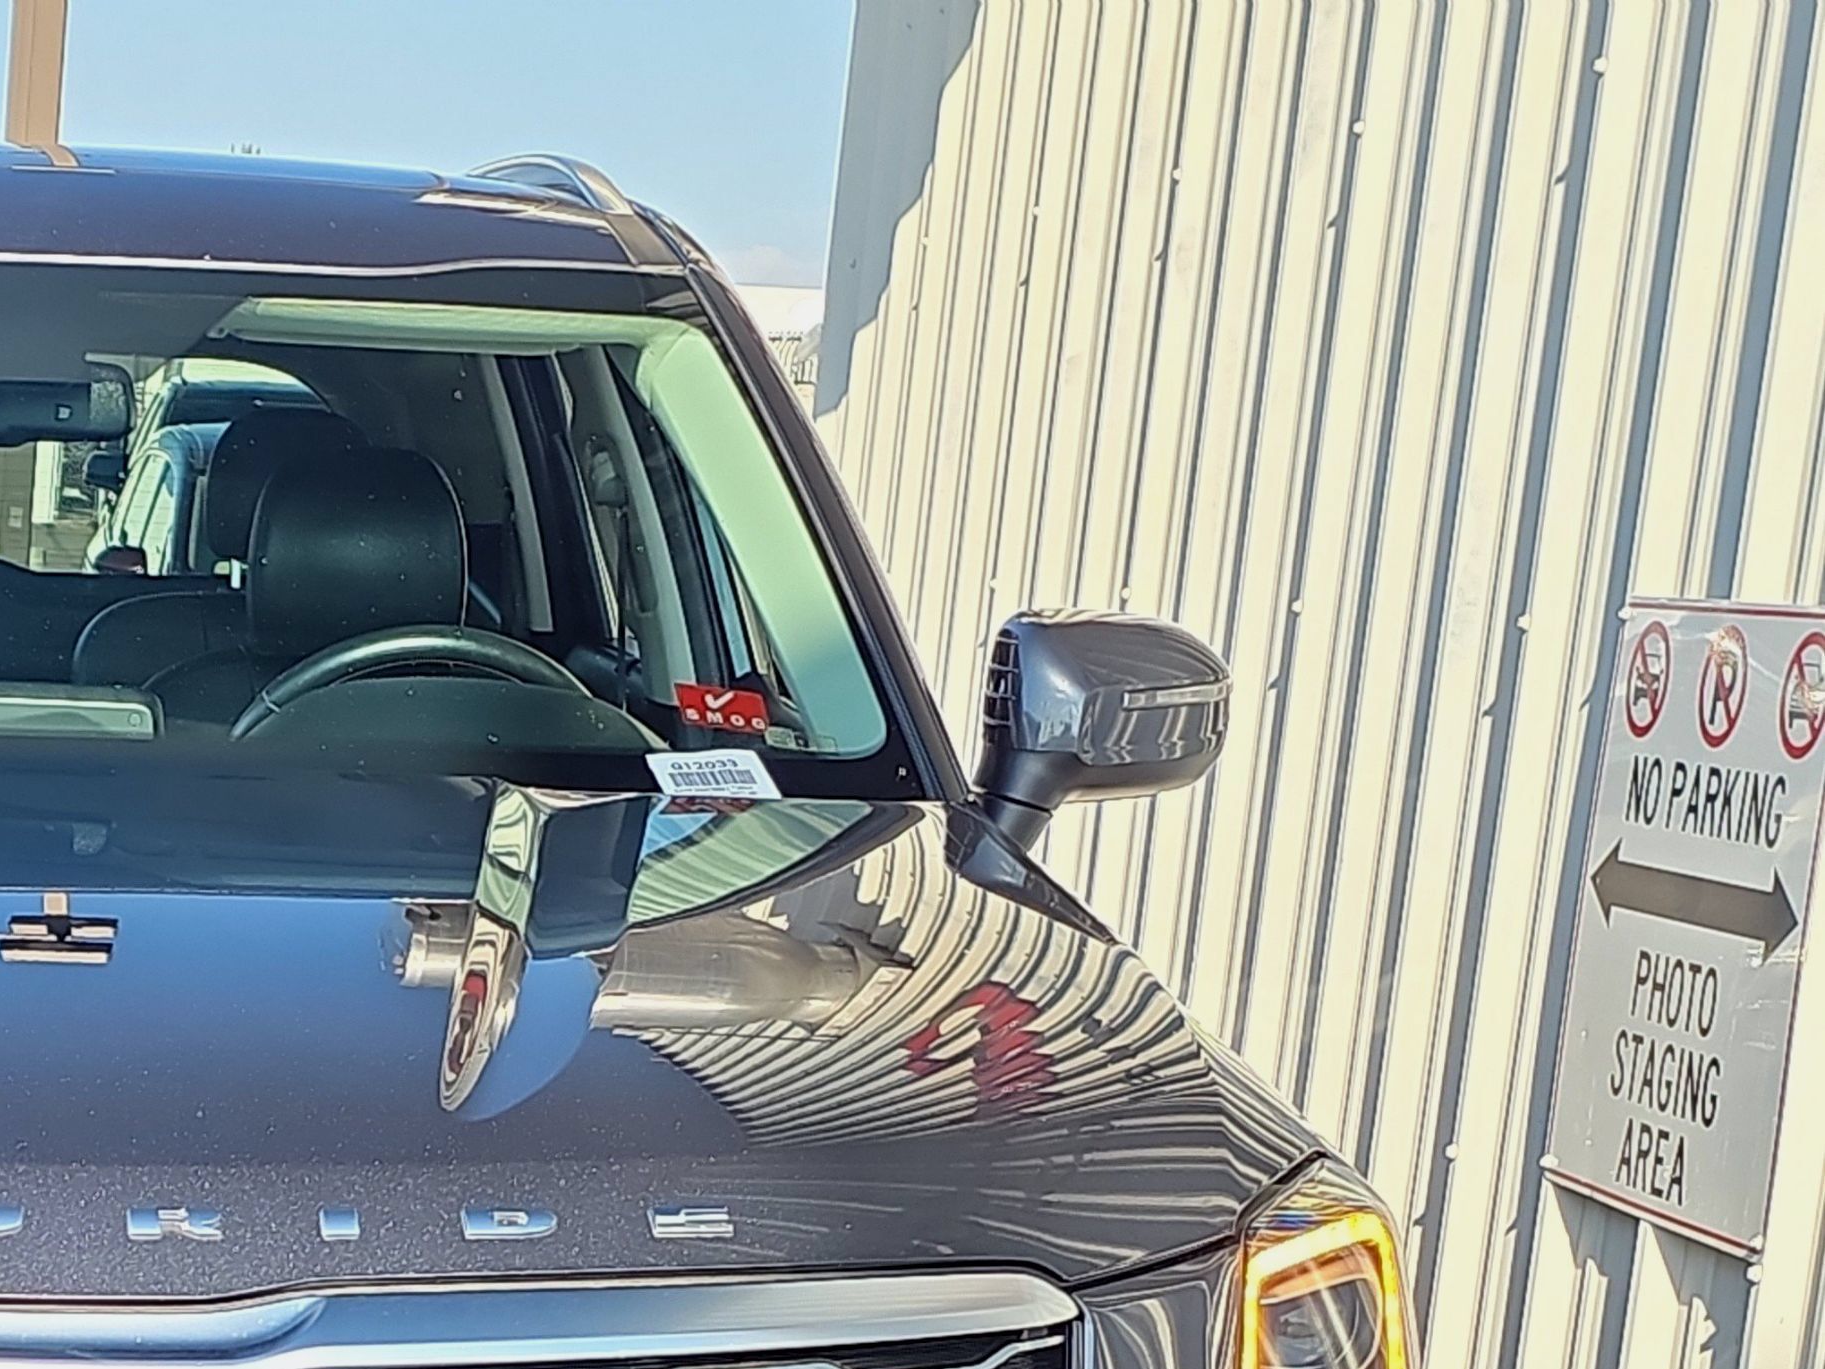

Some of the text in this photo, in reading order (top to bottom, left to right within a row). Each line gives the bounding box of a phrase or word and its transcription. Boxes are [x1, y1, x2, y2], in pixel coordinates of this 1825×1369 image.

[685, 709, 765, 729] SMOG
[1626, 756, 1786, 848] NO PARKING
[1631, 949, 1717, 1037] PHOTO
[1611, 1031, 1718, 1128] STAGING
[1615, 1117, 1685, 1207] AREA
